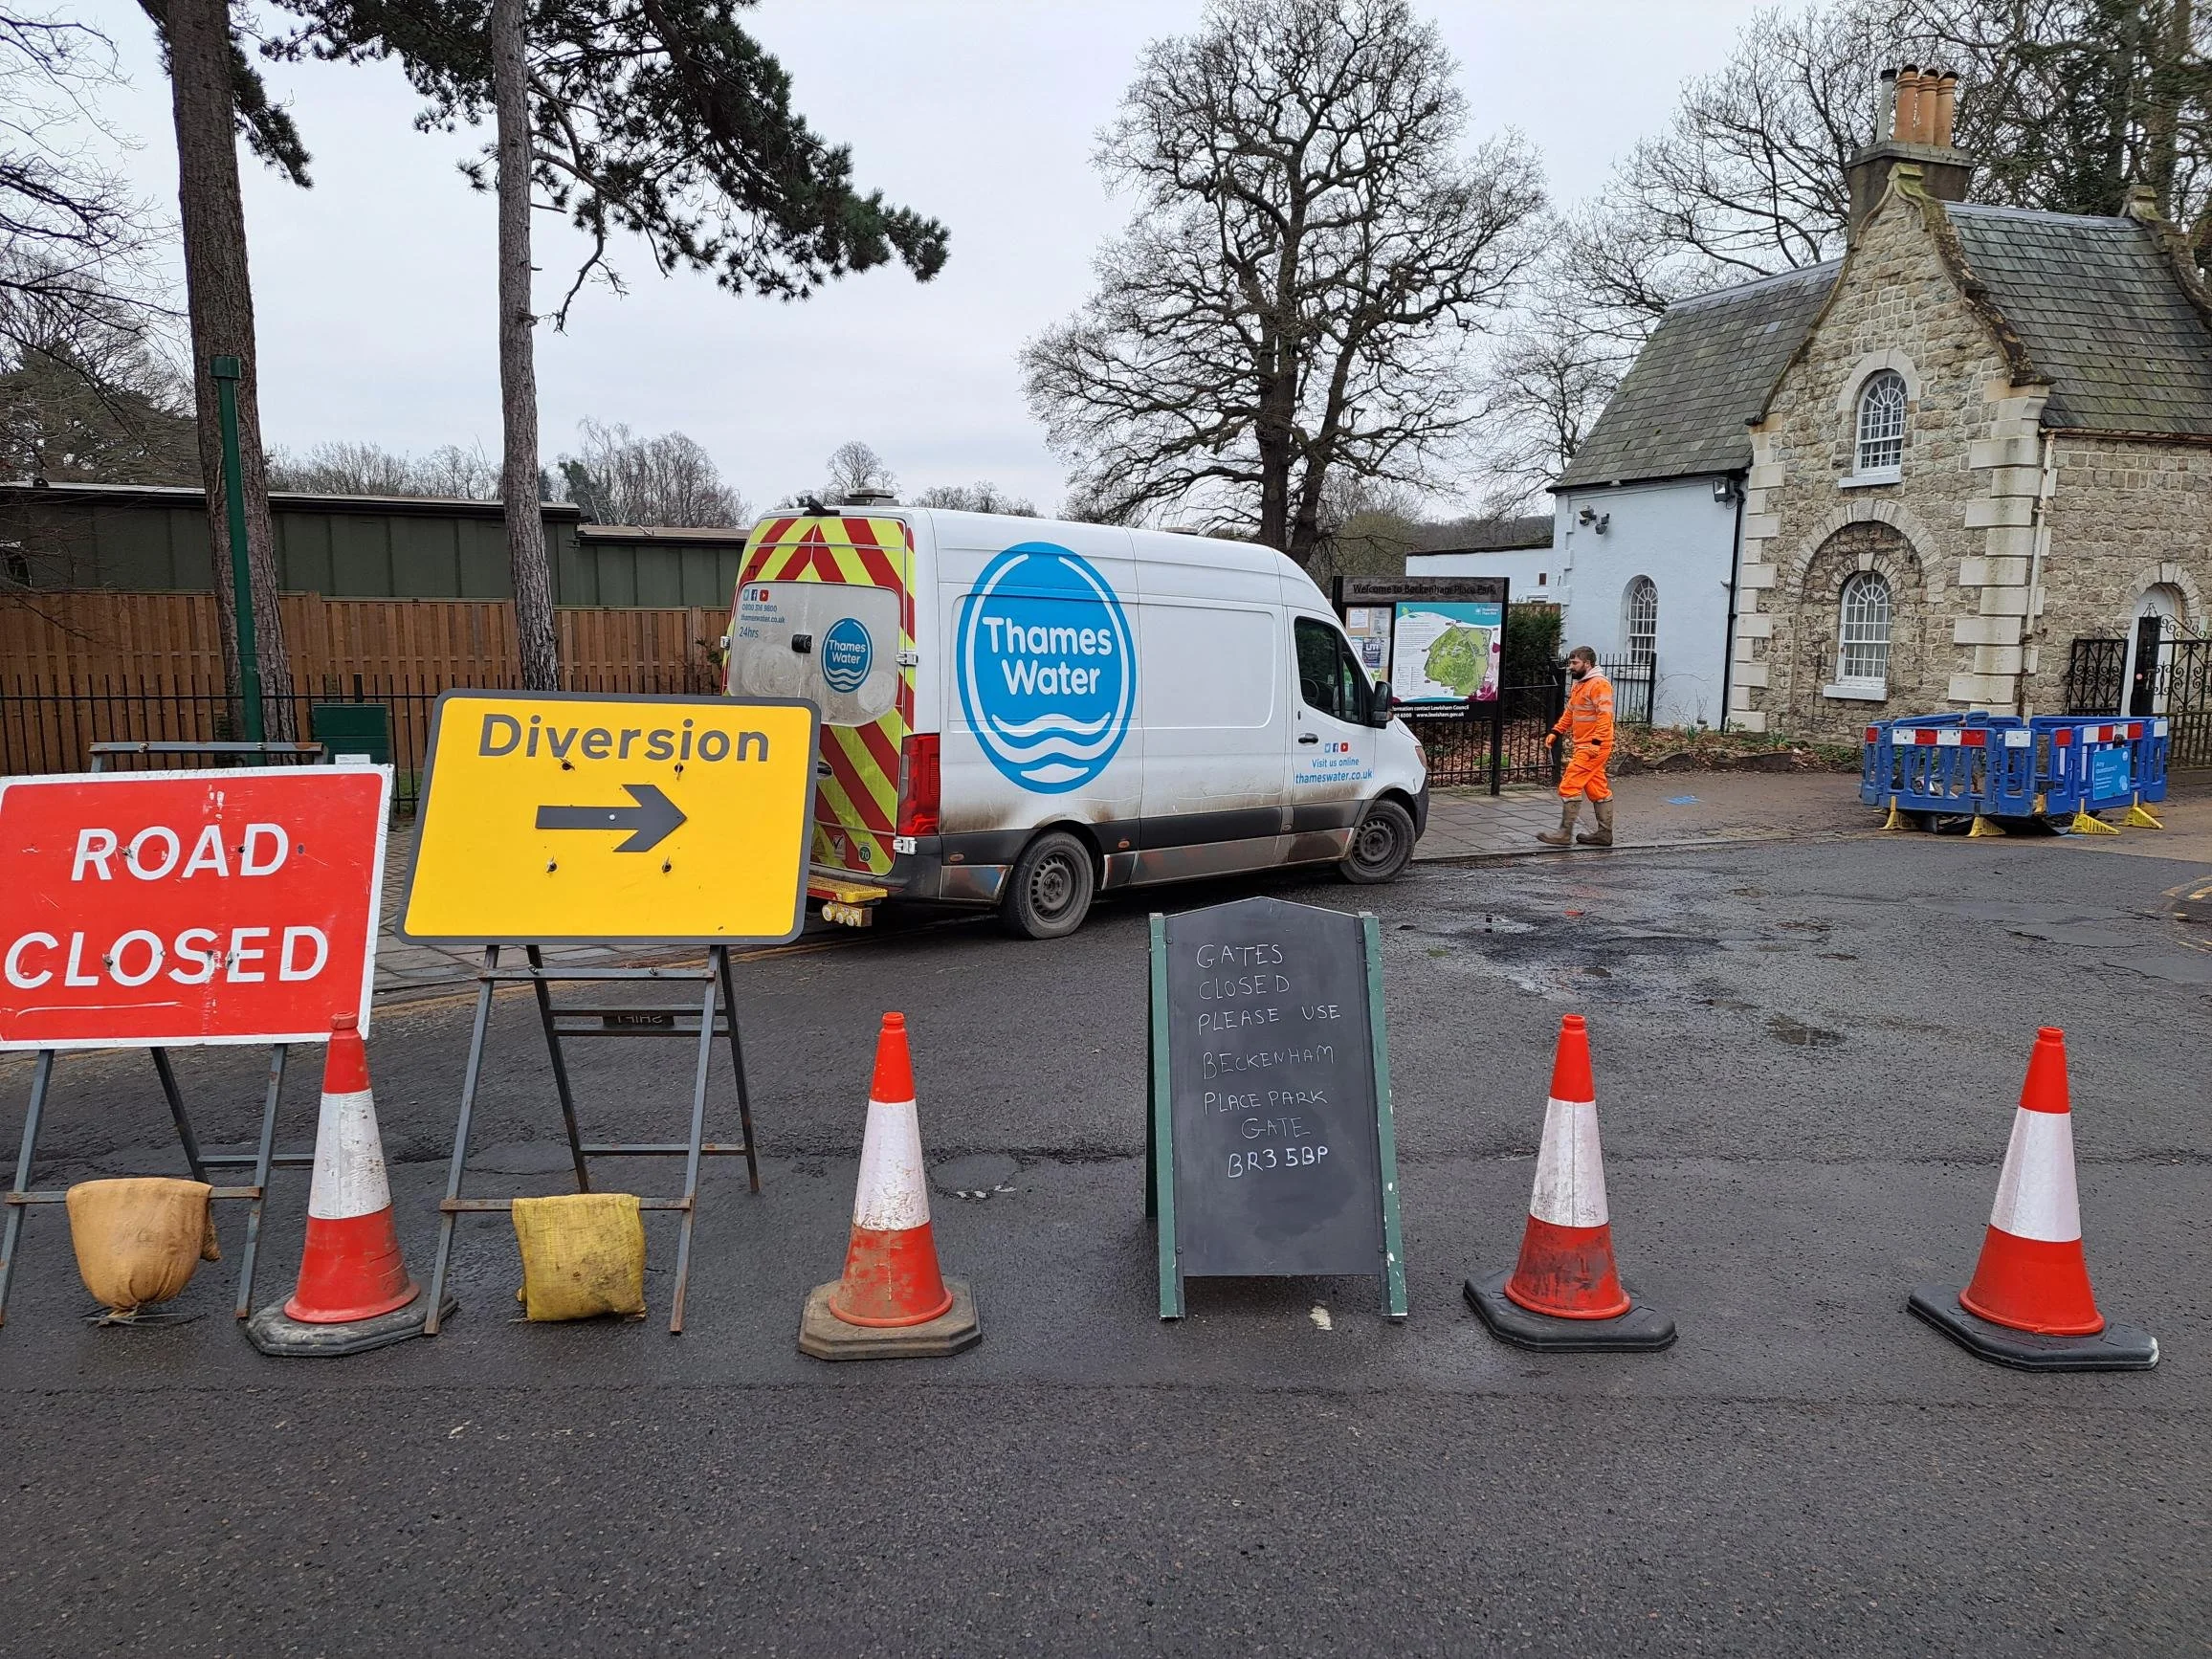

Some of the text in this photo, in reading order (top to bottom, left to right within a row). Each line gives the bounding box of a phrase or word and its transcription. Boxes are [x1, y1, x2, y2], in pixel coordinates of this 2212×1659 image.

[1352, 585, 1391, 594] Welcome
[1392, 585, 1403, 594] to
[1405, 585, 1452, 595] Beckenham
[1454, 585, 1476, 594] Place
[739, 626, 759, 638] 24hrs
[983, 616, 1113, 655] Thames
[829, 639, 866, 653] Thames
[831, 652, 861, 664] Water
[1001, 658, 1101, 696] Water
[478, 713, 770, 763] Diversion
[1312, 758, 1328, 768] Visit
[1338, 757, 1360, 766] online
[1295, 768, 1373, 785] thameswater.co.uk
[71, 823, 289, 882] ROAD
[4, 925, 329, 989] CLOSED
[1196, 943, 1284, 970] GATES
[1199, 975, 1290, 1001] CLOSED
[1198, 1004, 1341, 1037] PLEASE USE
[1202, 1044, 1335, 1080] BECKENHAM
[1204, 1089, 1329, 1116] PLACE PARK
[1241, 1117, 1311, 1140] GATE
[1227, 1146, 1330, 1179] BR3 5BP
